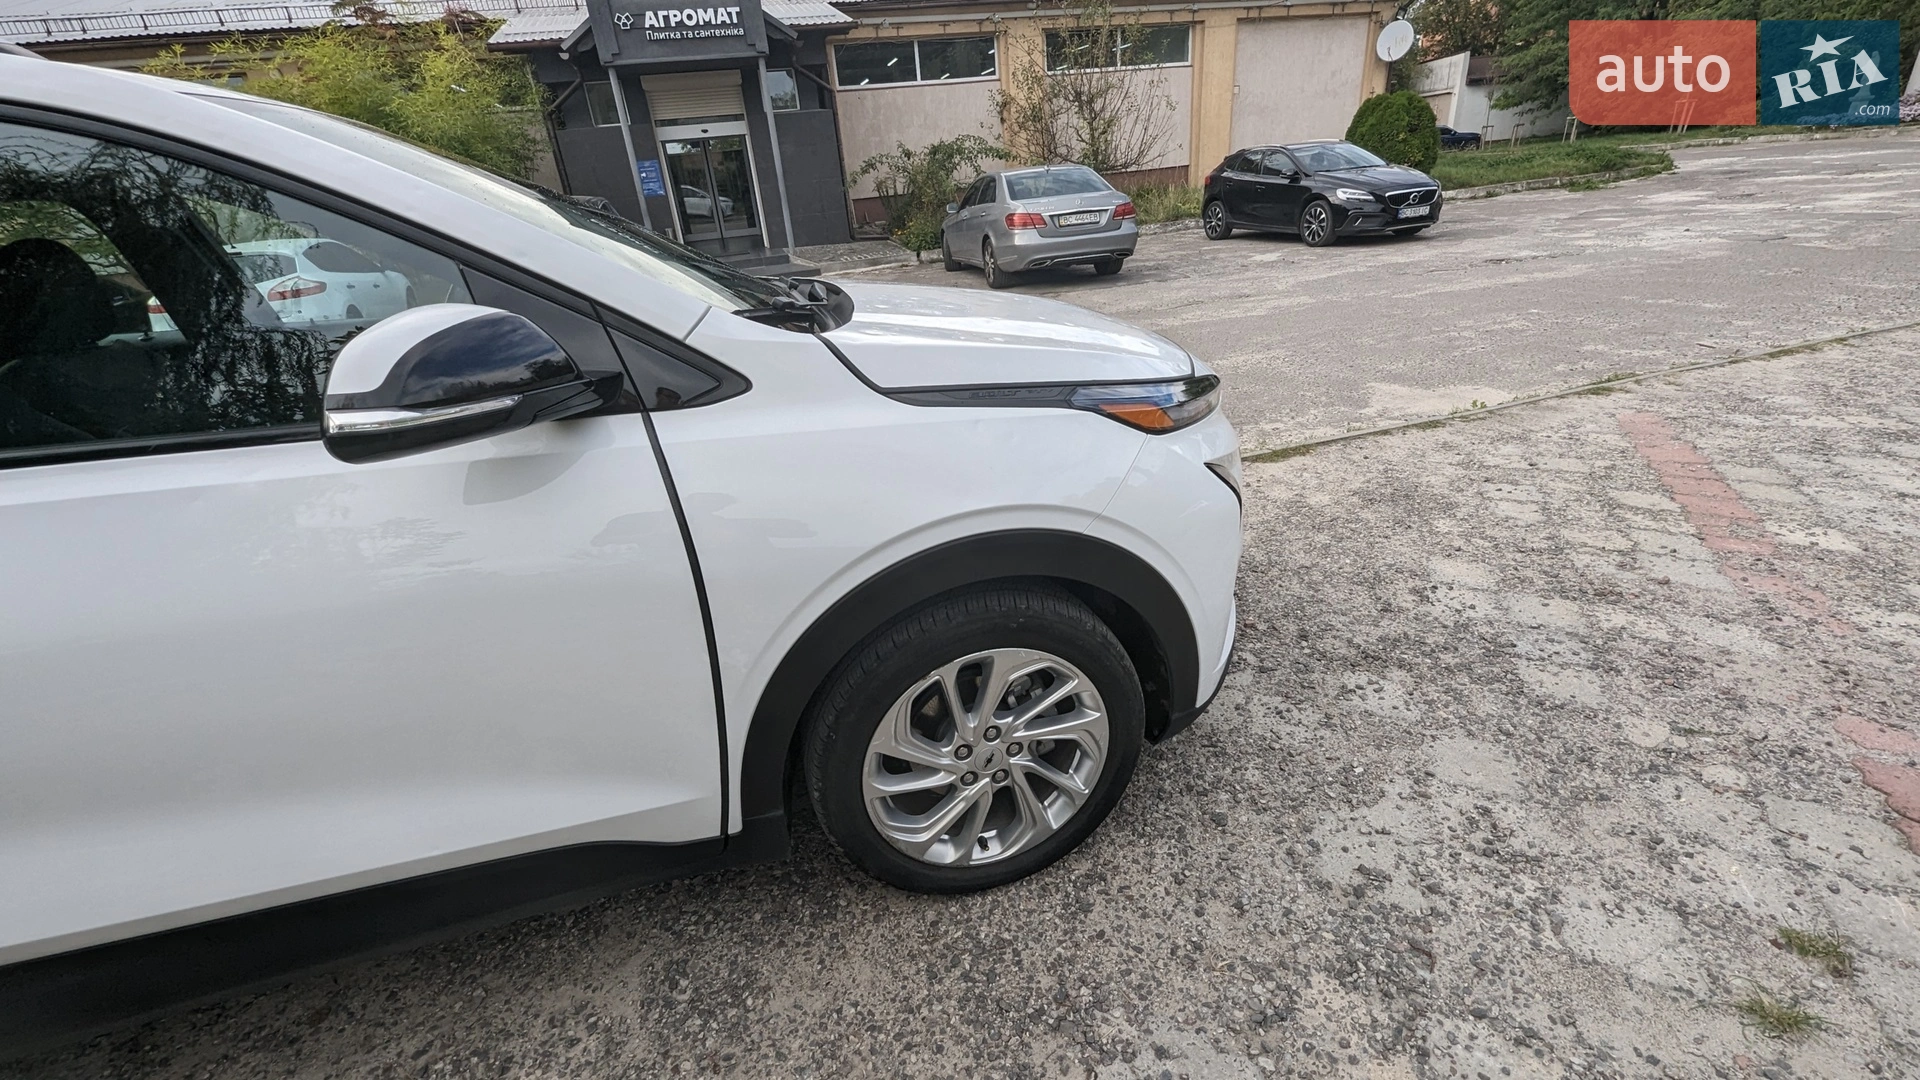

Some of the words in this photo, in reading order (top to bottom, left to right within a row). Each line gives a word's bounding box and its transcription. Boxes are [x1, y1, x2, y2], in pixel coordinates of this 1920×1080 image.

[645, 7, 740, 28] АГРОМАТ
[646, 30, 681, 41] Плитка
[682, 30, 693, 39] та
[694, 26, 745, 38] сантехніка
